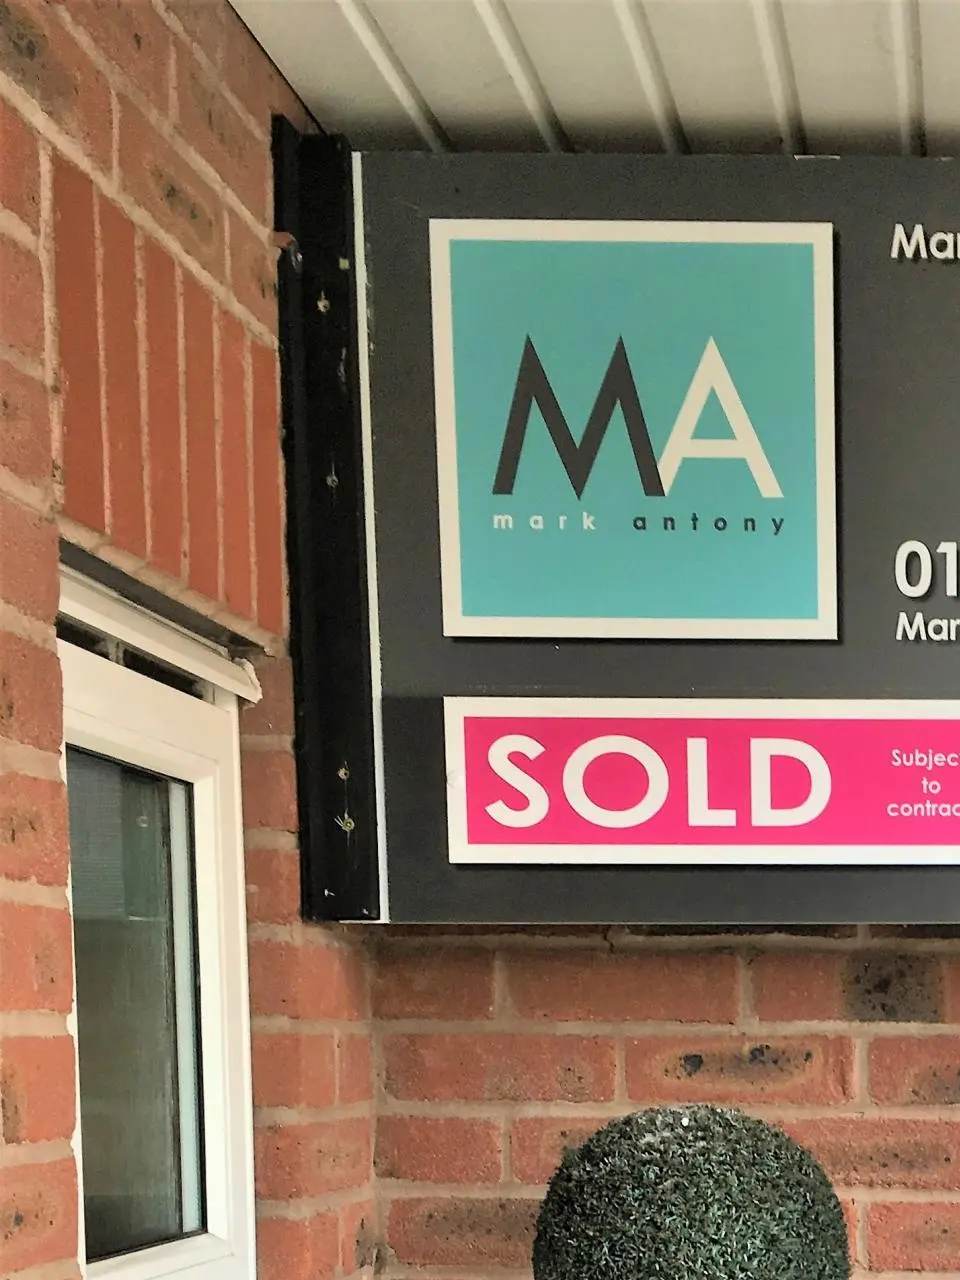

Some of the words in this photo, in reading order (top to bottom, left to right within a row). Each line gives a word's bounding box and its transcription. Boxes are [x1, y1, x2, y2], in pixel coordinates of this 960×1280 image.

[492, 334, 784, 500] MA
[492, 511, 596, 531] mark
[632, 512, 785, 536] antony
[484, 734, 832, 829] SOLD
[921, 776, 941, 794] to
